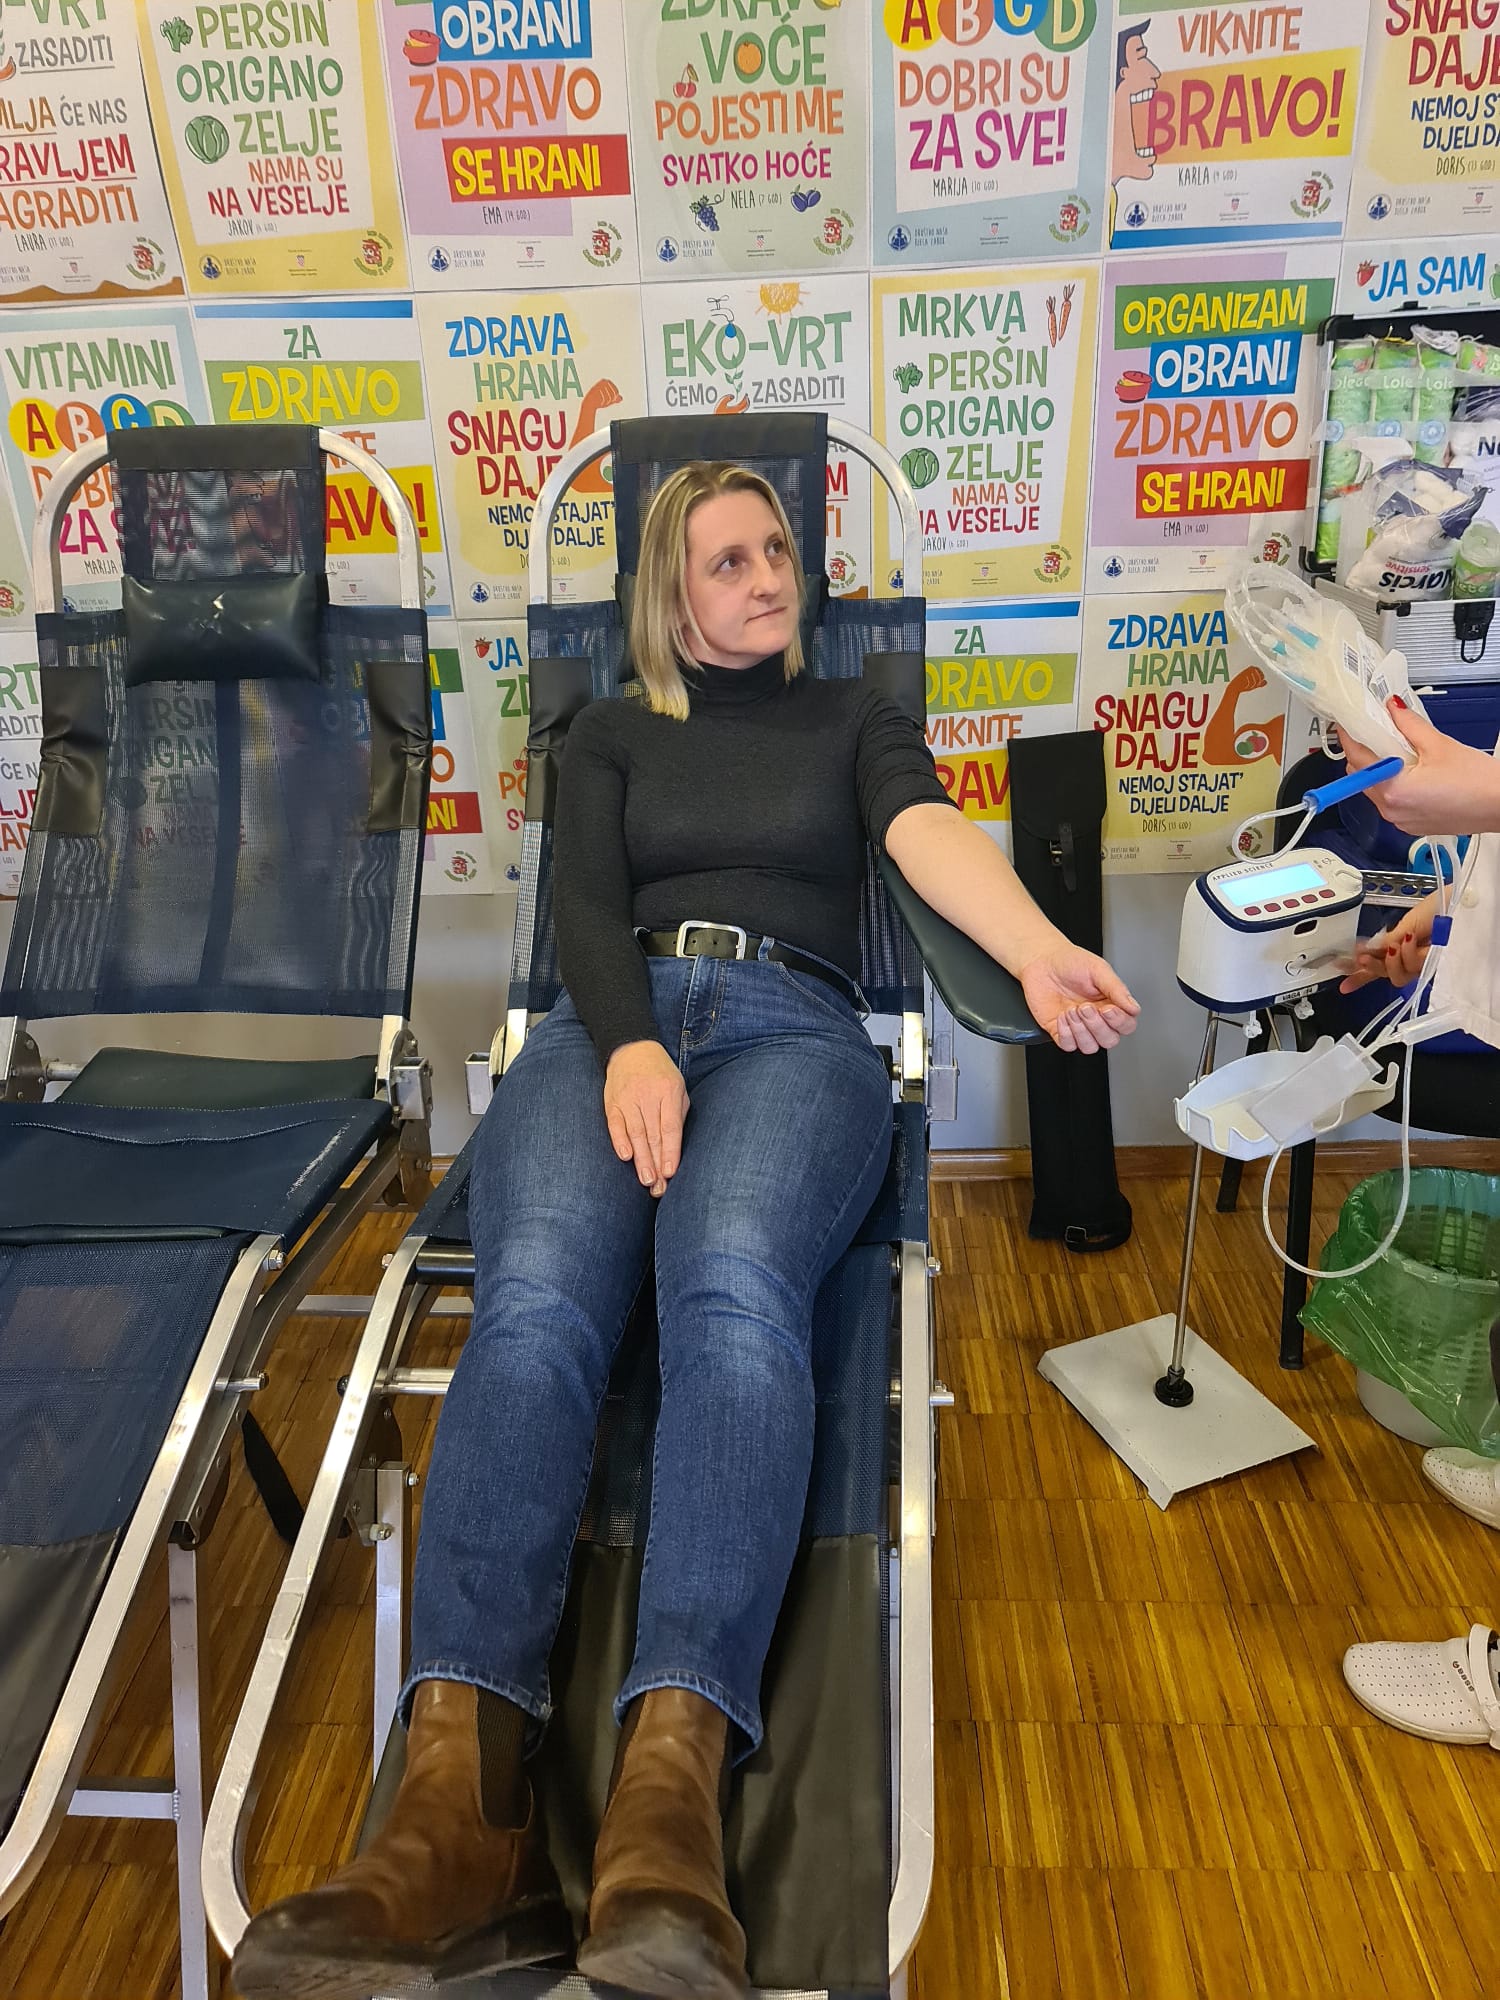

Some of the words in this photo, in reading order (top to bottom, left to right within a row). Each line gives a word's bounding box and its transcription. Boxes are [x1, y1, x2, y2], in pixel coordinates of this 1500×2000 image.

[441, 0, 582, 56] OBRANI
[901, 0, 932, 43] A
[955, 0, 981, 42] B
[1052, 0, 1085, 45] D
[1177, 7, 1303, 57] VIKNITE
[15, 34, 114, 68] ZASADITI
[700, 12, 827, 86] VOĆE
[176, 55, 344, 105] ORIGANO
[409, 63, 602, 130] ZDRAVO
[899, 57, 1011, 112] DOBRI
[1020, 53, 1070, 104] SU
[59, 96, 85, 127] ĆE
[88, 98, 128, 124] NAS
[655, 93, 788, 146] POJESTI
[795, 87, 844, 136] ME
[1147, 69, 1346, 155] BRAVO!
[1411, 93, 1480, 122] NEMOJ
[233, 108, 342, 157] ZELJE
[910, 113, 963, 171] ZA
[975, 107, 1067, 169] SVE!
[1422, 125, 1480, 151] DIJELI
[248, 158, 312, 185] NAMA
[316, 156, 344, 182] SU
[452, 146, 497, 198] SE
[499, 143, 602, 193] HRANI
[662, 150, 759, 187] SVATKO
[765, 141, 832, 181] HOĆE
[1178, 165, 1210, 187] KARLA
[1436, 156, 1466, 176] DORIS
[207, 189, 243, 218] NA
[247, 184, 350, 217] VESELJE
[731, 190, 755, 209] NELA
[932, 177, 968, 198] MARIJA
[228, 219, 254, 237] JAKOV
[482, 206, 503, 225] EMA
[15, 232, 47, 252] LAURA
[1369, 259, 1407, 302] JA
[1417, 253, 1486, 297] SAM
[899, 290, 1026, 338] MRKVA
[1122, 285, 1307, 335] ORGANIZAM
[283, 325, 322, 360] ZA
[445, 313, 575, 358] ZDRAVA
[662, 311, 852, 378] EKO-VRT
[6, 337, 176, 392] VITAMINI
[473, 358, 583, 402] HRANA
[928, 335, 1049, 391] PERŠIN
[1155, 340, 1291, 394] OBRANI
[222, 365, 400, 423] ZDRAVO
[665, 382, 718, 408] ĆEMO
[751, 375, 846, 404] ZASADITI
[26, 403, 56, 451] A
[67, 406, 95, 450] B
[448, 407, 566, 455] SNAGU
[899, 395, 1054, 439] ORIGANO
[1114, 399, 1298, 458] ZDRAVO
[946, 440, 1043, 484] ZELJE
[952, 482, 1008, 507] NAMA
[1015, 481, 1040, 504] SU
[1141, 470, 1182, 514] SE
[1187, 466, 1287, 510] HRANI
[554, 527, 606, 548] DALJE
[947, 506, 1040, 534] VESELJE
[1163, 522, 1181, 537] EMA
[84, 559, 118, 575] MARIJA
[954, 626, 986, 655] ZA
[1107, 610, 1229, 650] ZDRAVA
[488, 637, 524, 671] JA
[1127, 649, 1231, 688] HRANA
[1093, 691, 1210, 733] SNAGU
[1115, 732, 1201, 773] DAJE
[1118, 775, 1174, 795] NEMOJ
[1130, 796, 1177, 816] DIJELI
[1179, 794, 1230, 814] DALJE
[1142, 819, 1167, 833] DORIS
[1212, 870, 1242, 881] APPLIED
[1244, 862, 1274, 874] SCIENCE
